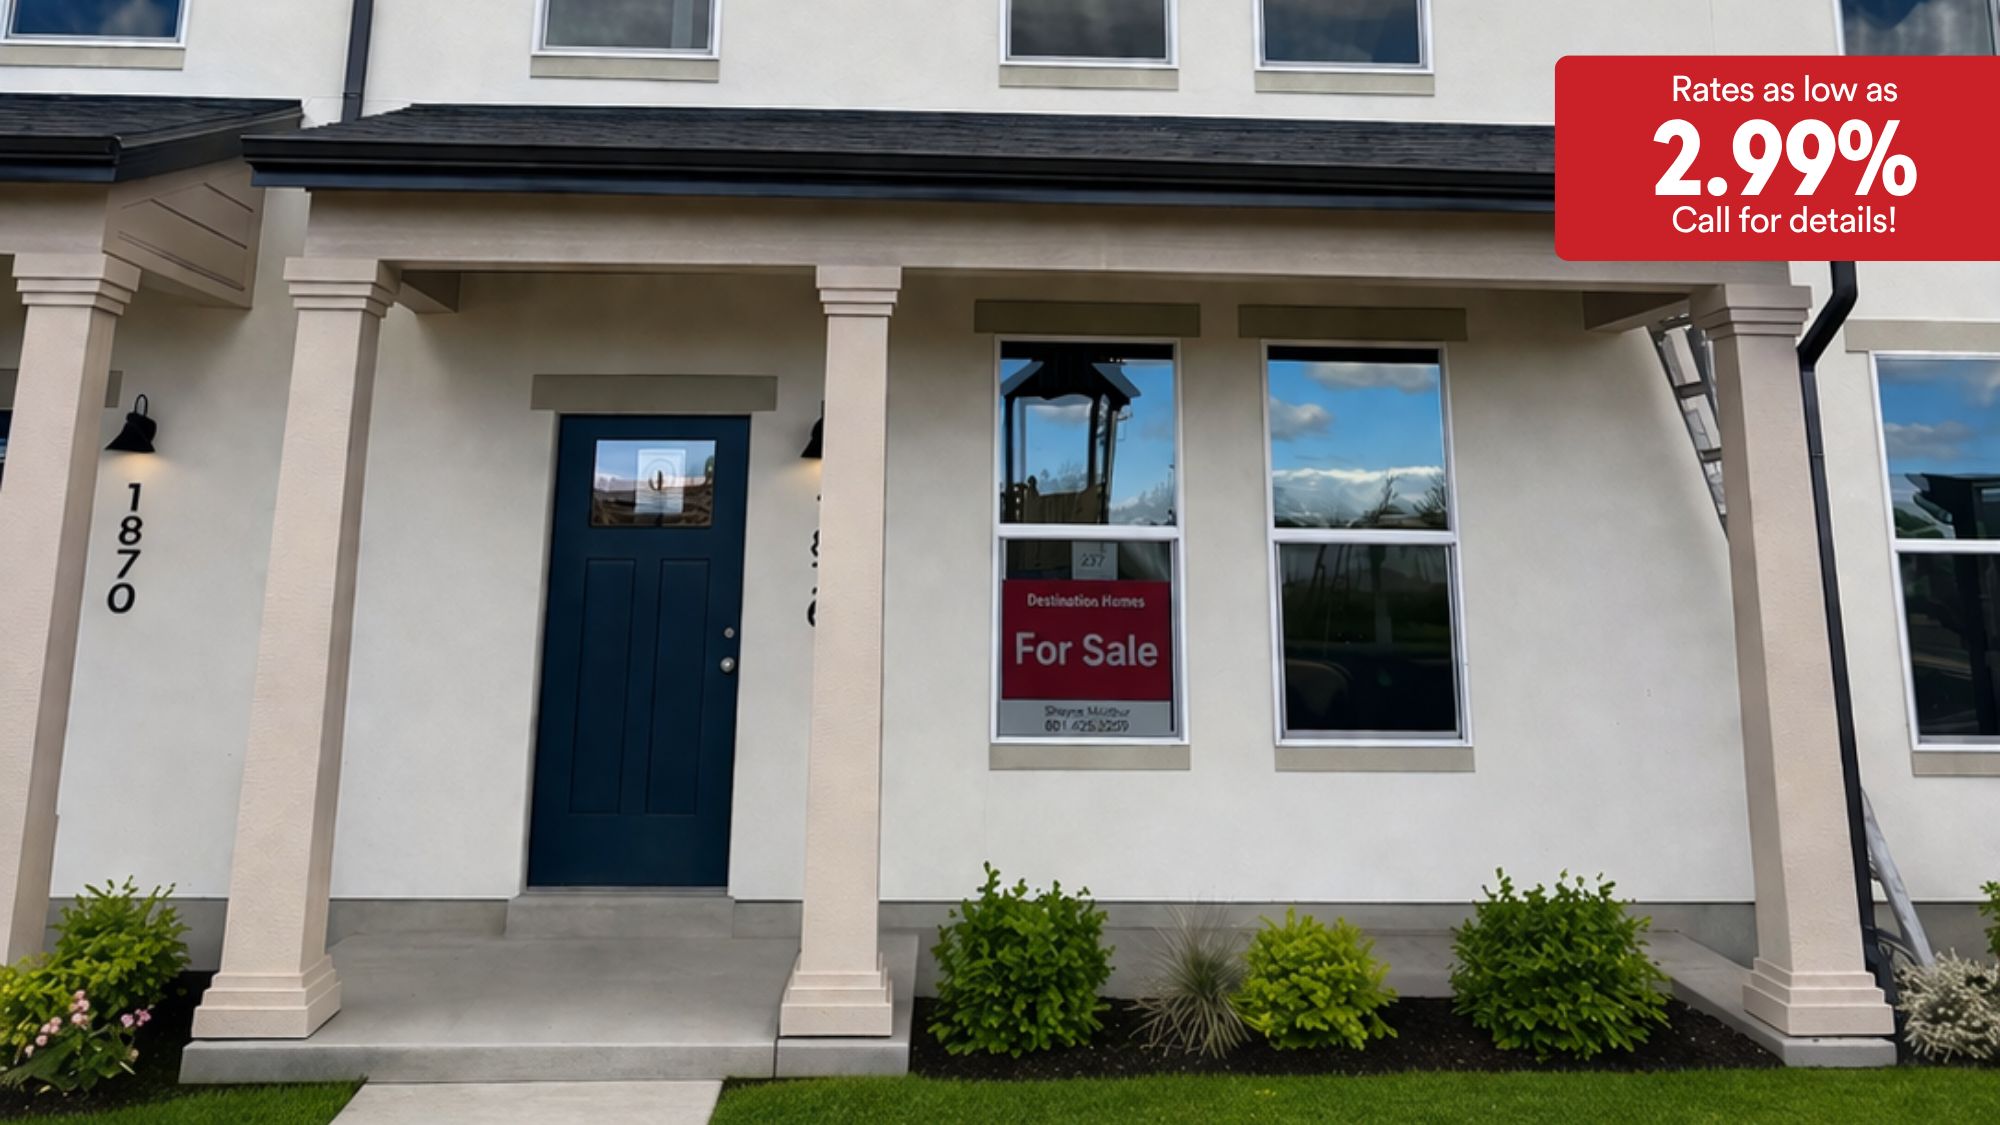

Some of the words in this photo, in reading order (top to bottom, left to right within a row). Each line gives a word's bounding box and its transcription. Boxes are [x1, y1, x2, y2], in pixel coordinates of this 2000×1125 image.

[107, 483, 143, 614] 1870
[1027, 593, 1099, 607] Destination
[1101, 594, 1146, 608] Homes
[1016, 632, 1073, 665] For
[1082, 633, 1158, 666] Sale
